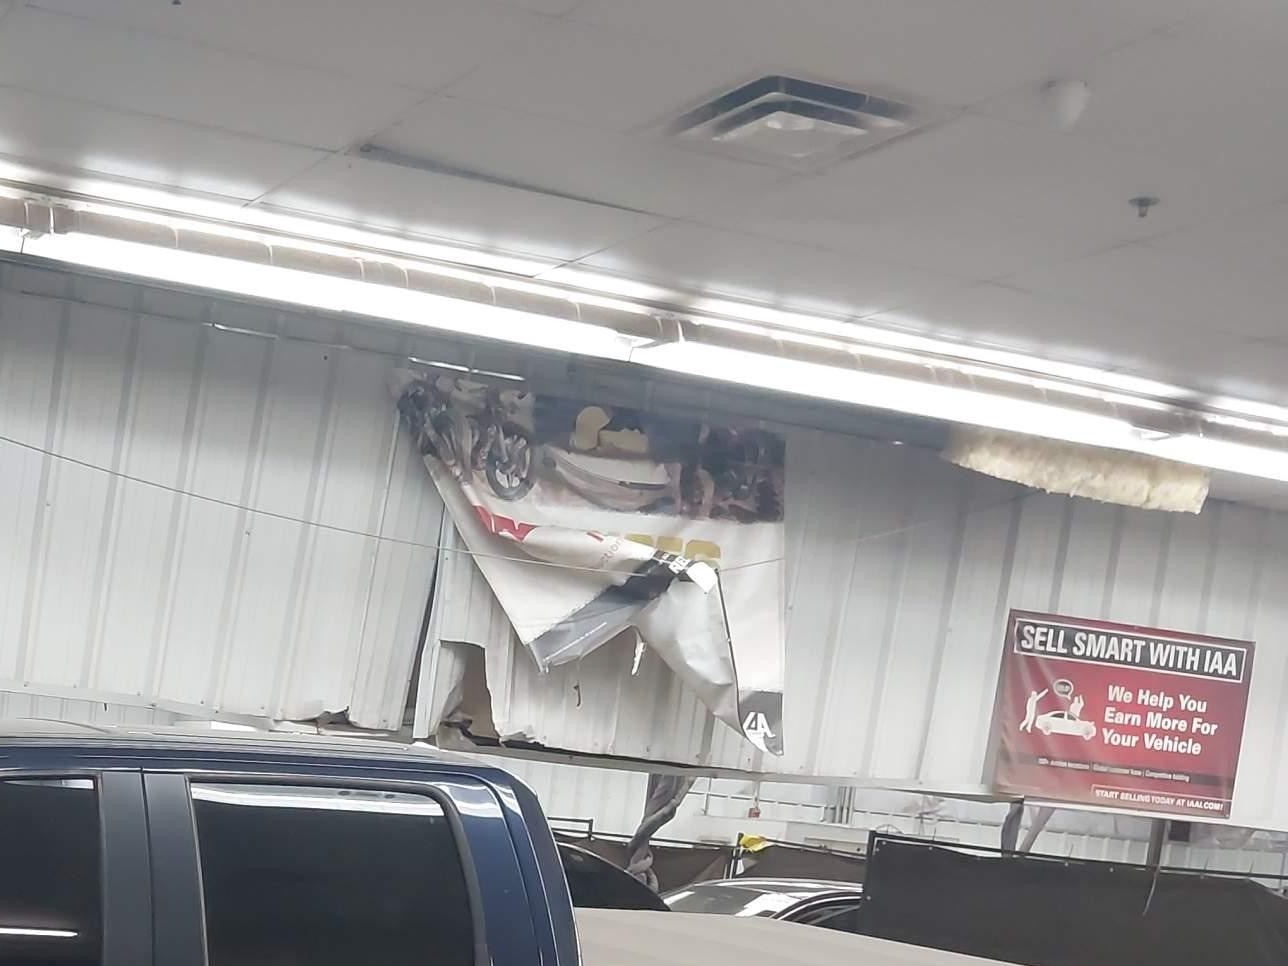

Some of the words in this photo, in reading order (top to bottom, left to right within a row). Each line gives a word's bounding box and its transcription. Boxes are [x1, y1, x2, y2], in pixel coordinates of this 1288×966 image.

[1021, 625, 1067, 654] SELL
[1073, 632, 1146, 663] SMART
[1150, 642, 1200, 671] WITH
[1204, 650, 1236, 676] IAA
[1108, 685, 1133, 703] We
[1137, 689, 1174, 712] Help
[1179, 694, 1208, 713] You
[1104, 706, 1141, 727] Earn
[1146, 711, 1188, 732] More
[1192, 717, 1218, 735] For
[1102, 728, 1139, 747] Your
[1144, 733, 1202, 755] Vehicle
[1095, 789, 1119, 800] START
[1120, 792, 1150, 803] SELLING
[1151, 795, 1175, 805] TODAY
[1176, 798, 1186, 806] AT
